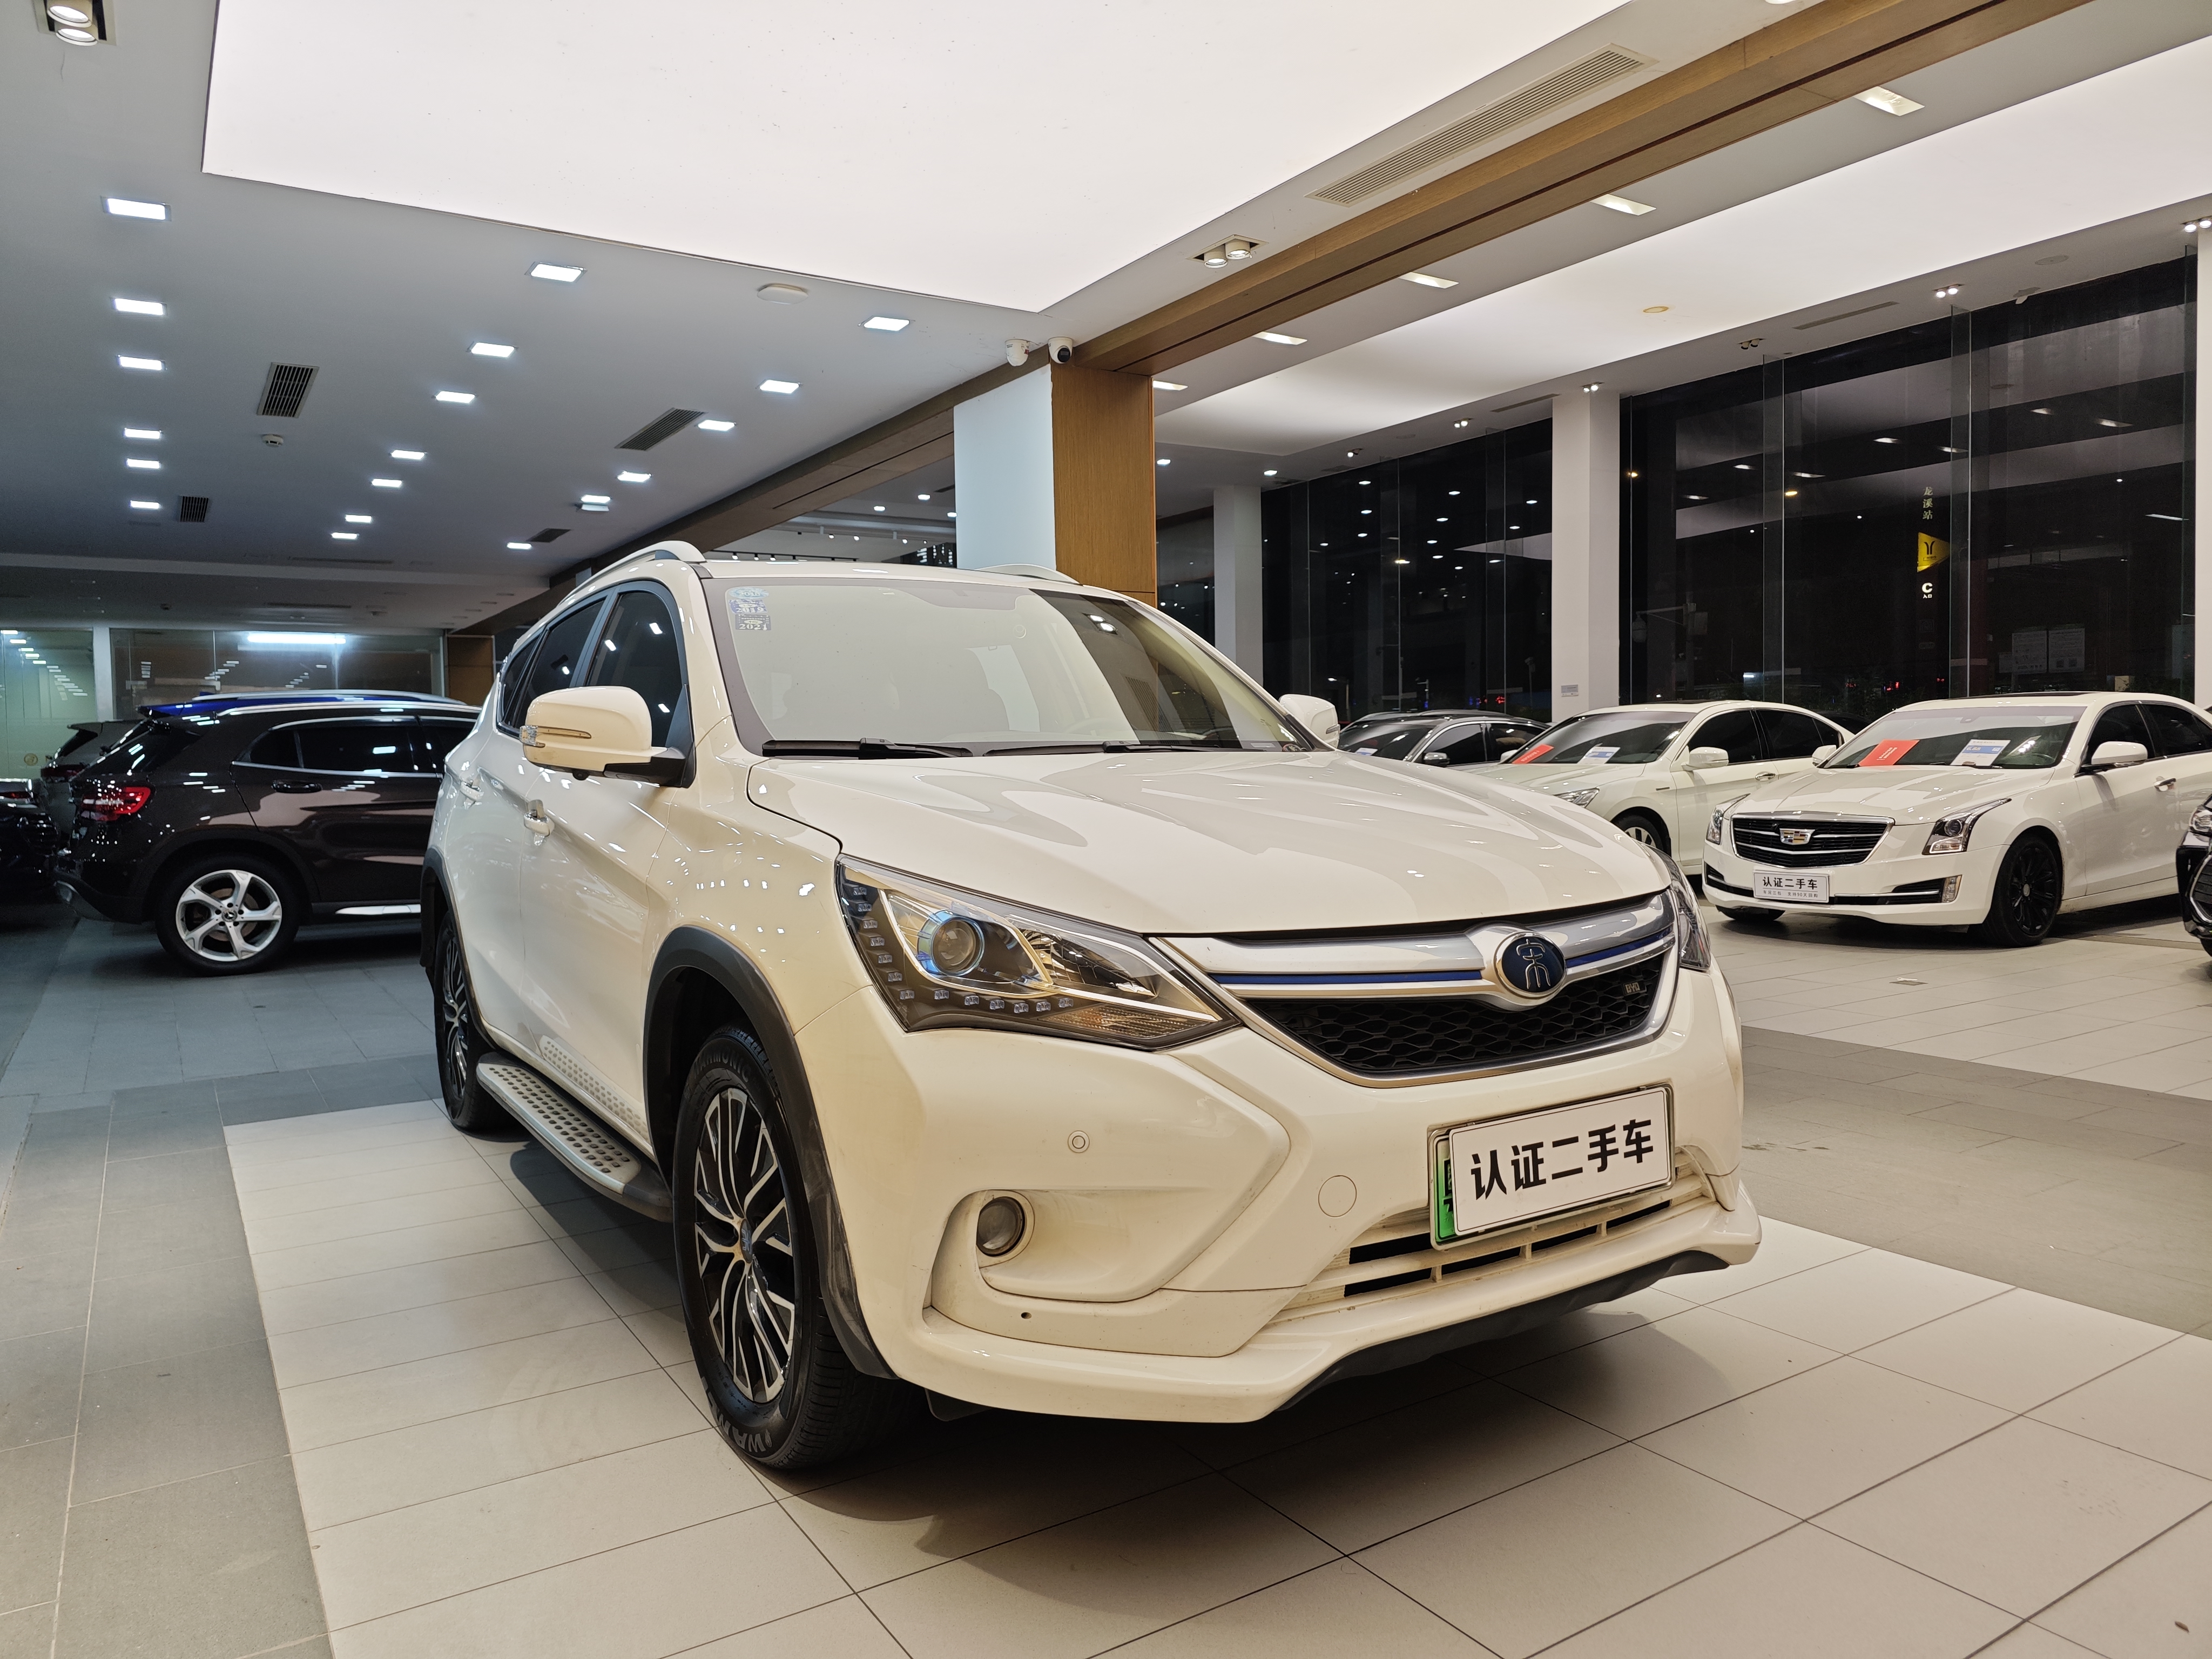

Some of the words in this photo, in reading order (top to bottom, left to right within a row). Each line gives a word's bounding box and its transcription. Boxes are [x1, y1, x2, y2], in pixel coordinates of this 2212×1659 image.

[1923, 487, 1933, 520] 龙溪站
[1922, 583, 1933, 593] C
[1763, 876, 1817, 890] 认证二手车
[1625, 982, 1640, 993] BYD
[1471, 1119, 1653, 1200] 认证二手车
